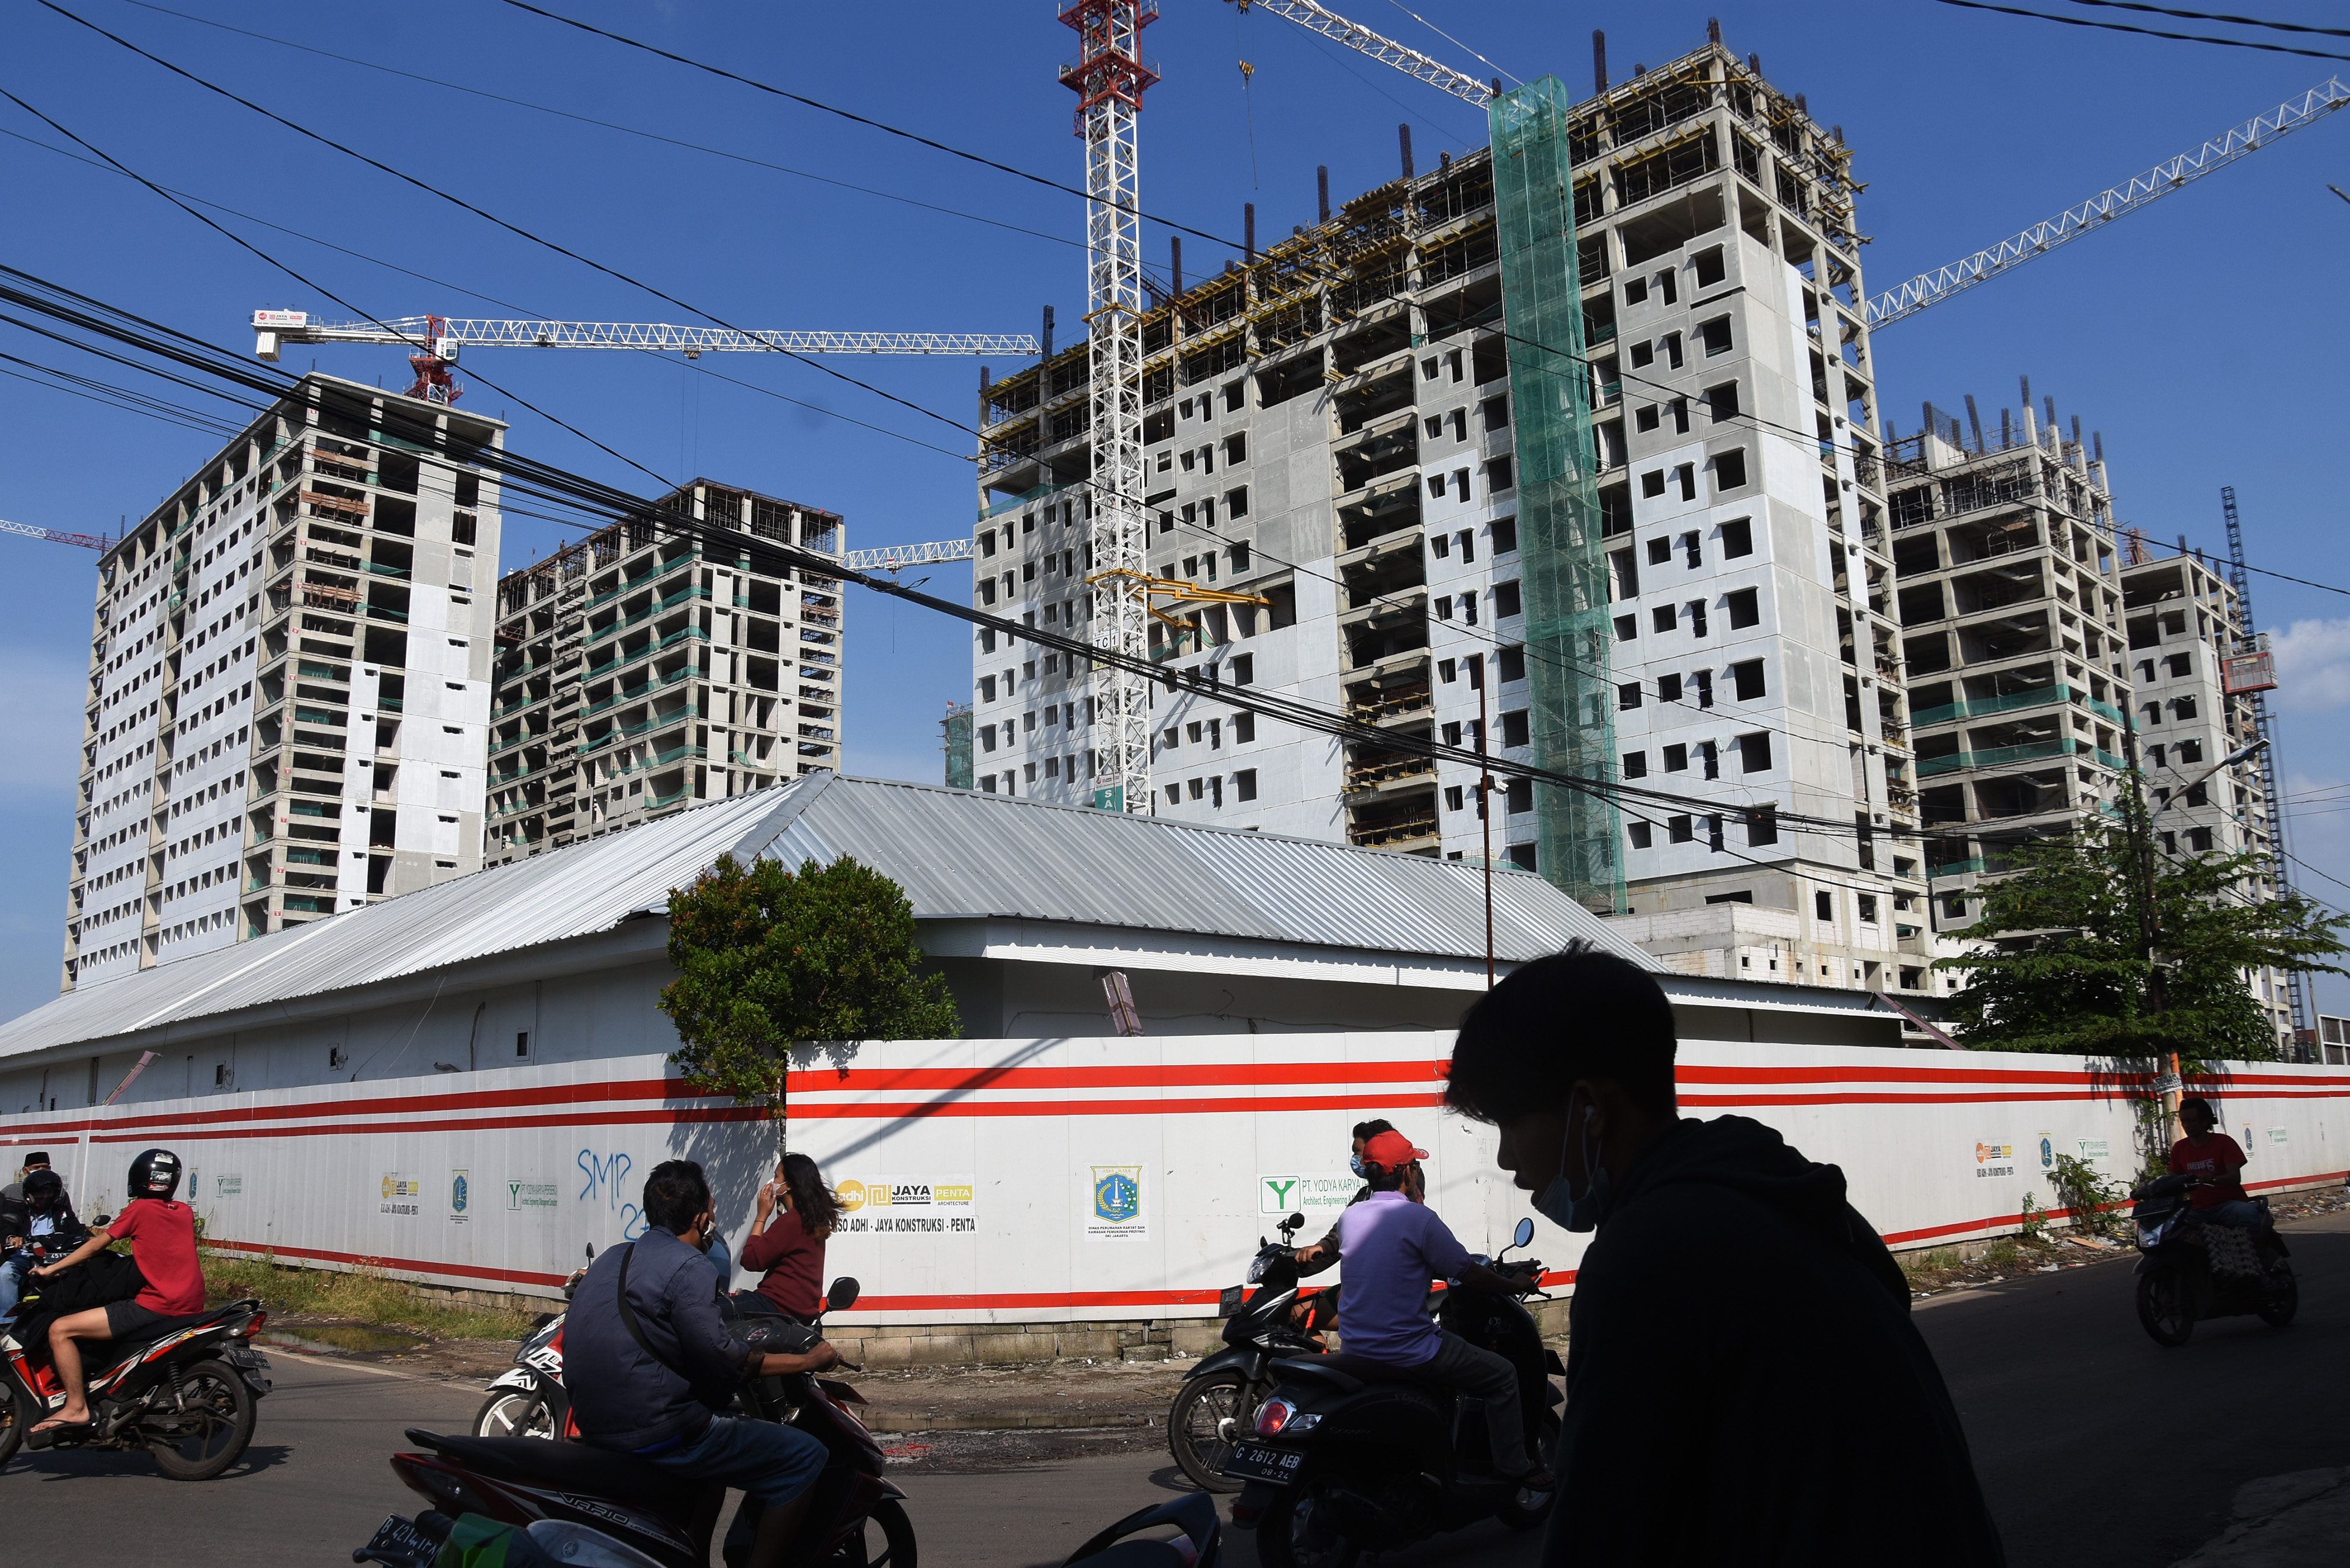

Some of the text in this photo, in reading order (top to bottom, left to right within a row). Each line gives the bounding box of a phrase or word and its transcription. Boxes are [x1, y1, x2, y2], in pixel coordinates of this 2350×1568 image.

[1096, 634, 1116, 648] TC 1
[578, 1149, 632, 1211] SMP
[1302, 1180, 1312, 1192] PT.
[1314, 1179, 1337, 1192] YODYA
[1338, 1178, 1361, 1191] KARYA
[892, 1185, 931, 1196] JAYA
[936, 1188, 970, 1197] PENTA
[1303, 1196, 1322, 1206] Architect,
[1324, 1195, 1347, 1207] Engineering
[837, 1218, 848, 1233] SO
[850, 1218, 868, 1233] ADHI
[875, 1218, 893, 1233] JAYA
[895, 1218, 944, 1233] KONSTRUKSI
[951, 1218, 976, 1232] PENTA
[1236, 1446, 1300, 1469] G 2612 AEB
[559, 1492, 629, 1525] VARIO
[381, 1517, 394, 1534] B
[630, 1524, 650, 1535] LIQUID
[651, 1532, 673, 1544] COOLED
